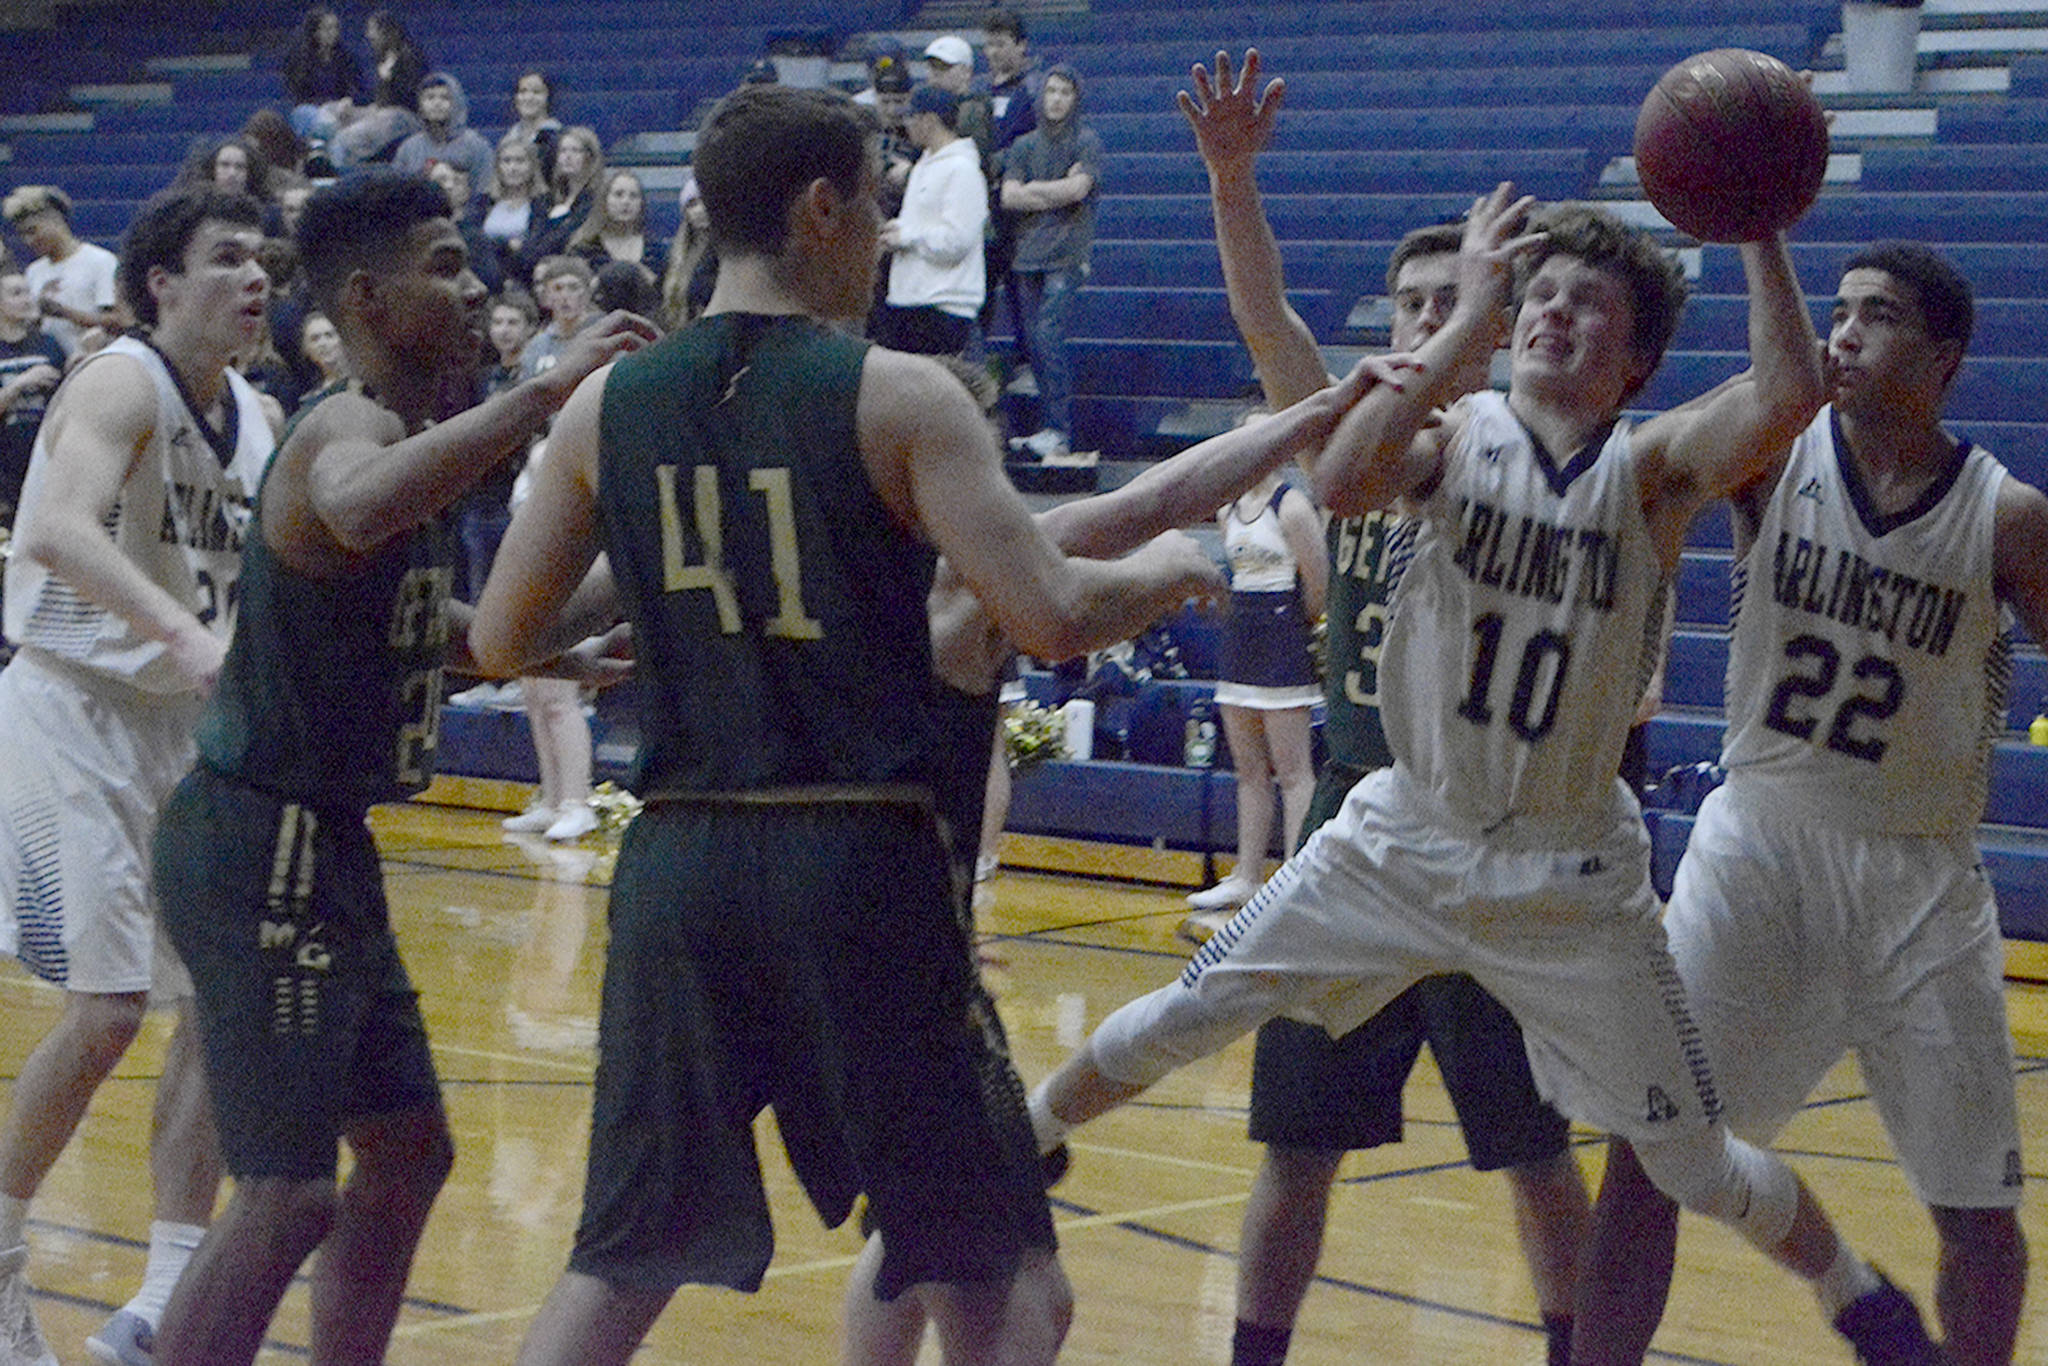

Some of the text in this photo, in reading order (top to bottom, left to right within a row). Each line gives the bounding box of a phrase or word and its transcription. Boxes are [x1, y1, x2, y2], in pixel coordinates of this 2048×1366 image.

[655, 464, 826, 641] 41
[1456, 612, 1571, 743] 10
[1763, 632, 1907, 764] 22
